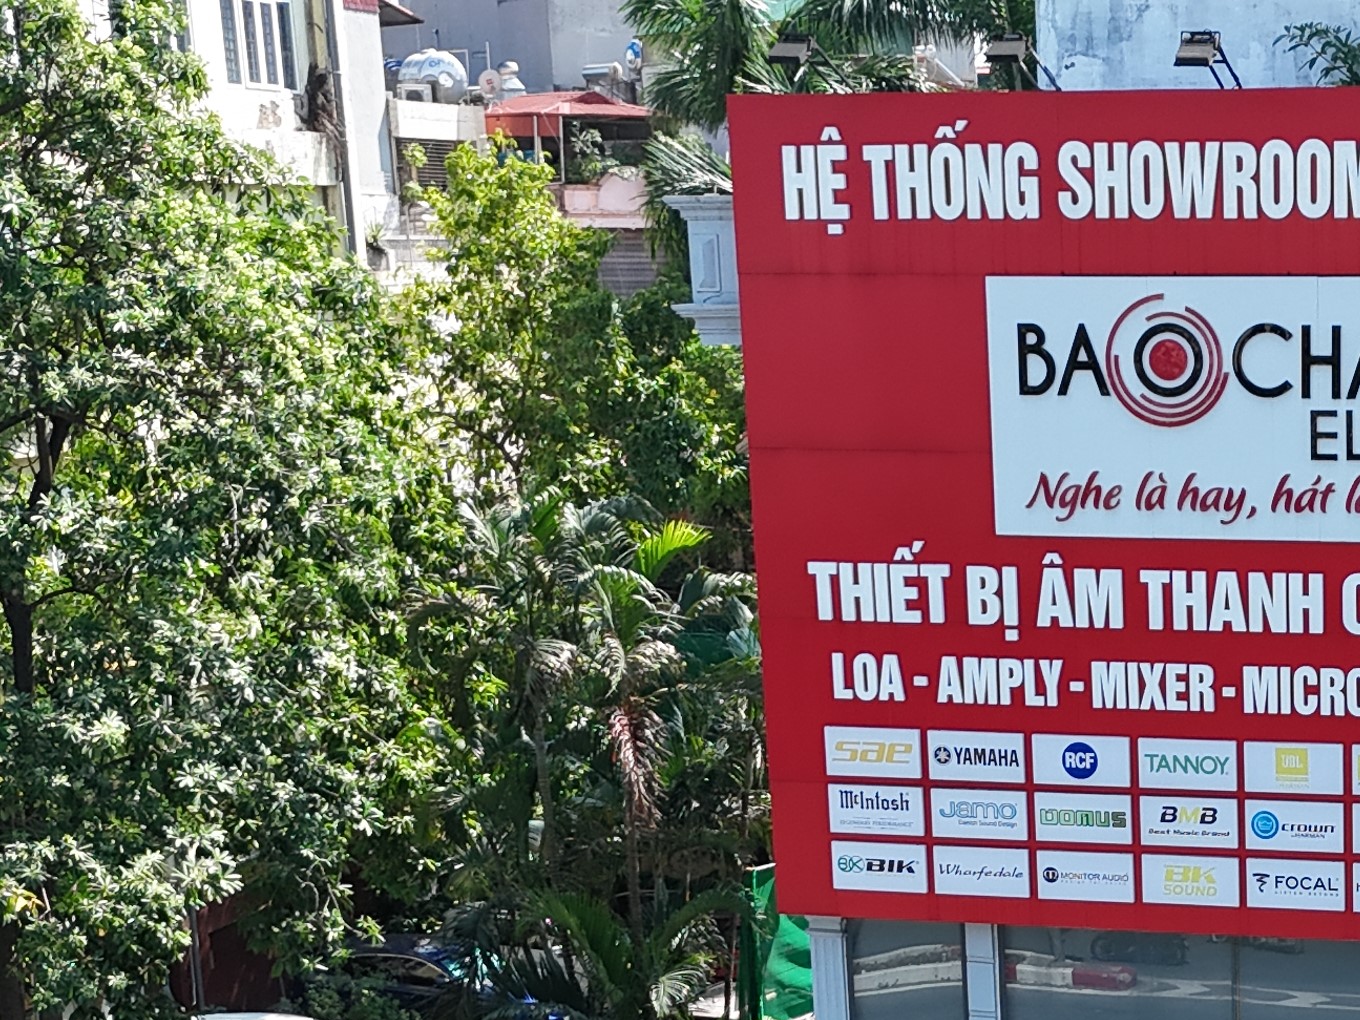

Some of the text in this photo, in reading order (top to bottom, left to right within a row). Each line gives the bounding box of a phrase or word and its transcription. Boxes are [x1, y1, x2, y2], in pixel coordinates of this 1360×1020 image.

[782, 125, 850, 235] HỆ
[862, 120, 1040, 220] THỐNG
[1026, 472, 1122, 524] Nghe
[1135, 470, 1168, 514] là
[1178, 475, 1257, 525] hay,
[1272, 471, 1335, 517] hát
[807, 541, 950, 624] THIẾT
[966, 564, 1020, 641] BỊ
[1037, 552, 1124, 630] ÂM
[1140, 569, 1324, 634] THANH
[831, 652, 906, 701] LOA
[937, 655, 1064, 707] AMPLY
[1091, 661, 1215, 713] MIXER
[953, 747, 1020, 767] YAMAHA
[1064, 752, 1095, 769] RCF
[1144, 754, 1230, 775] TANNOY
[839, 790, 910, 811] McIntosh
[1160, 806, 1218, 825] BMB
[1281, 824, 1335, 834] crown
[865, 858, 916, 874] BIK
[938, 864, 1024, 880] Wharfedale
[1061, 872, 1129, 882] MONITOR AUDIO
[1274, 876, 1339, 891] FOCAL
[1164, 884, 1217, 897] SOUND
